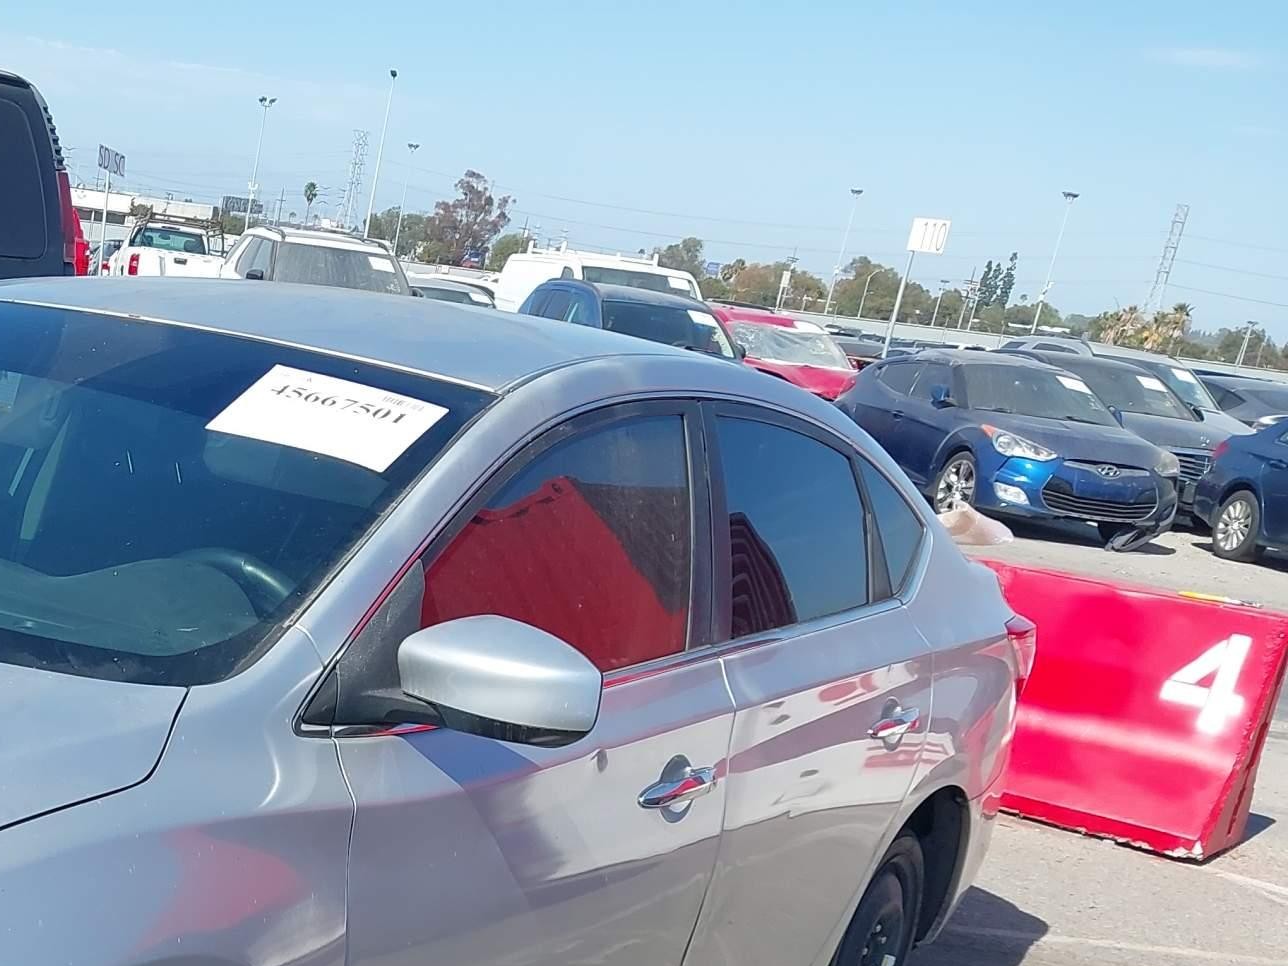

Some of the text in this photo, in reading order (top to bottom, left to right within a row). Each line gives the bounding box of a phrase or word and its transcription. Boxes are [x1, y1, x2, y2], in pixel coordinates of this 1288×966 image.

[98, 144, 111, 170] SD
[920, 221, 947, 251] 110
[269, 384, 408, 424] 45667501
[1159, 633, 1253, 736] 4
